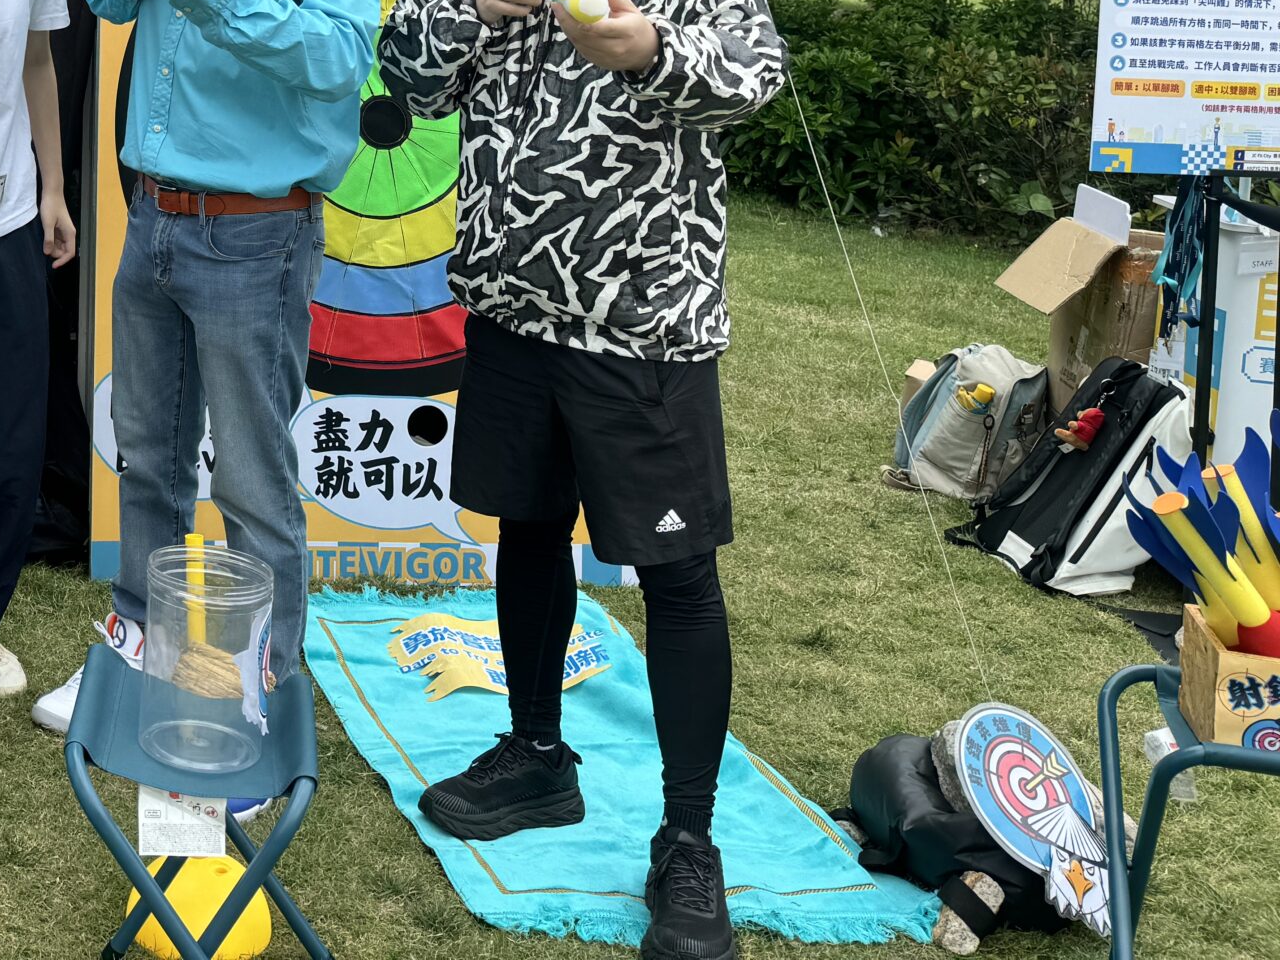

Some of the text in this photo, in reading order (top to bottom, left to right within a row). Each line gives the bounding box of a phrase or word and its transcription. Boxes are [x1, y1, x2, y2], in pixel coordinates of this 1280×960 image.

[1252, 259, 1274, 269] STAFF
[311, 407, 395, 453] 盡力
[314, 455, 444, 501] 就可以
[656, 522, 686, 533] adidas
[400, 652, 437, 674] Dare
[440, 647, 459, 655] to
[568, 629, 604, 646] vate
